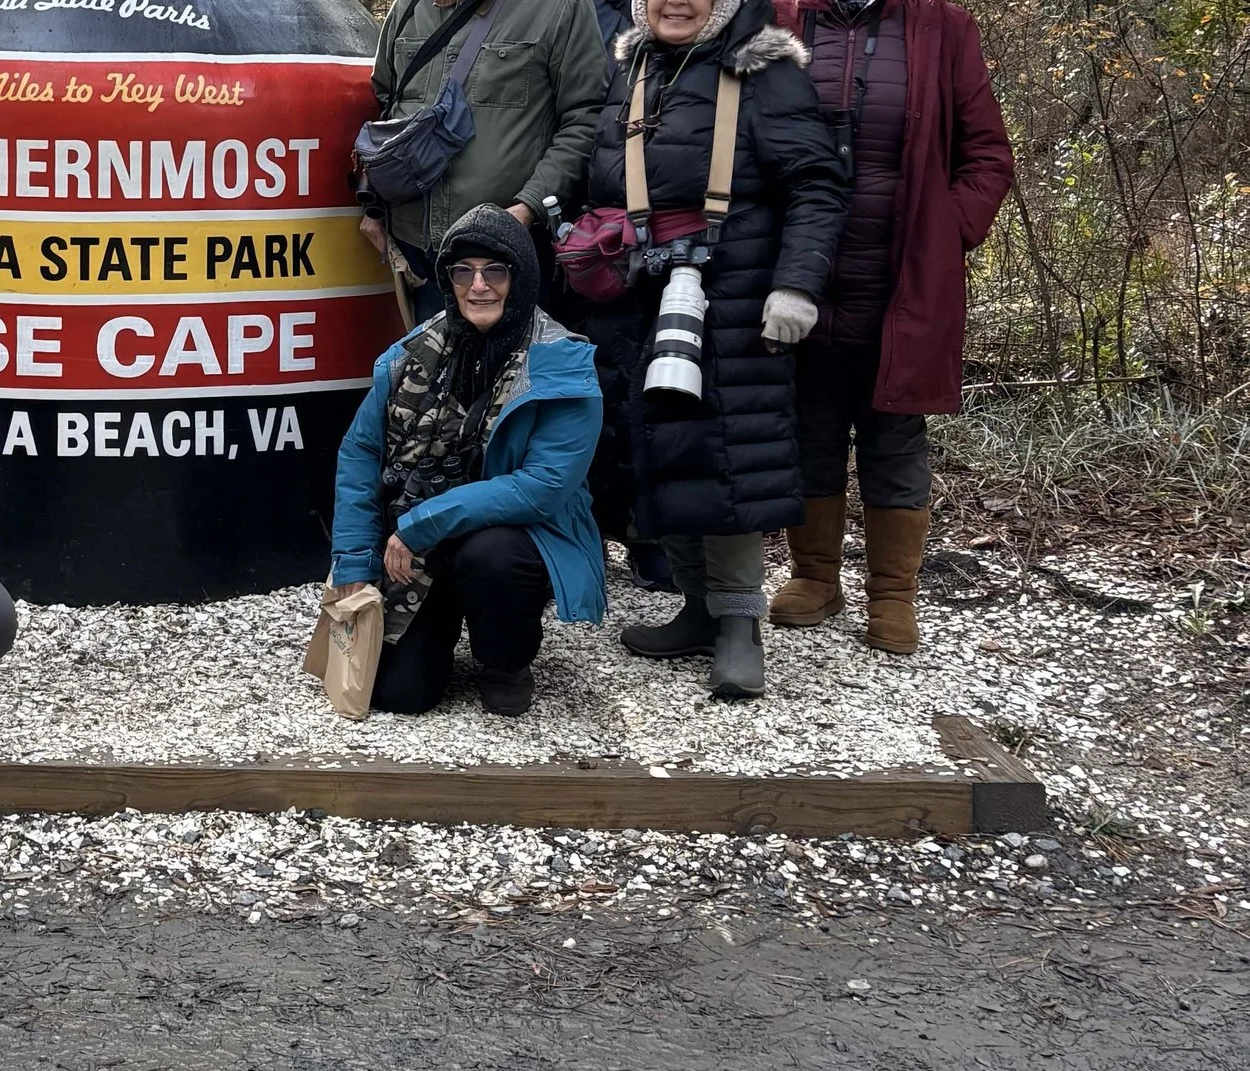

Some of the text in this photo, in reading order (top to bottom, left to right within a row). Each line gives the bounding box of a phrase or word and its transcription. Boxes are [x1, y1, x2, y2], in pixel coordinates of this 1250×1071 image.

[61, 77, 94, 103] to
[100, 73, 165, 113] Key
[174, 74, 246, 106] West
[40, 237, 188, 281] STATE
[206, 233, 316, 279] PARK
[96, 311, 316, 378] CAPE
[57, 410, 238, 460] BEACH,
[247, 406, 305, 452] VA
